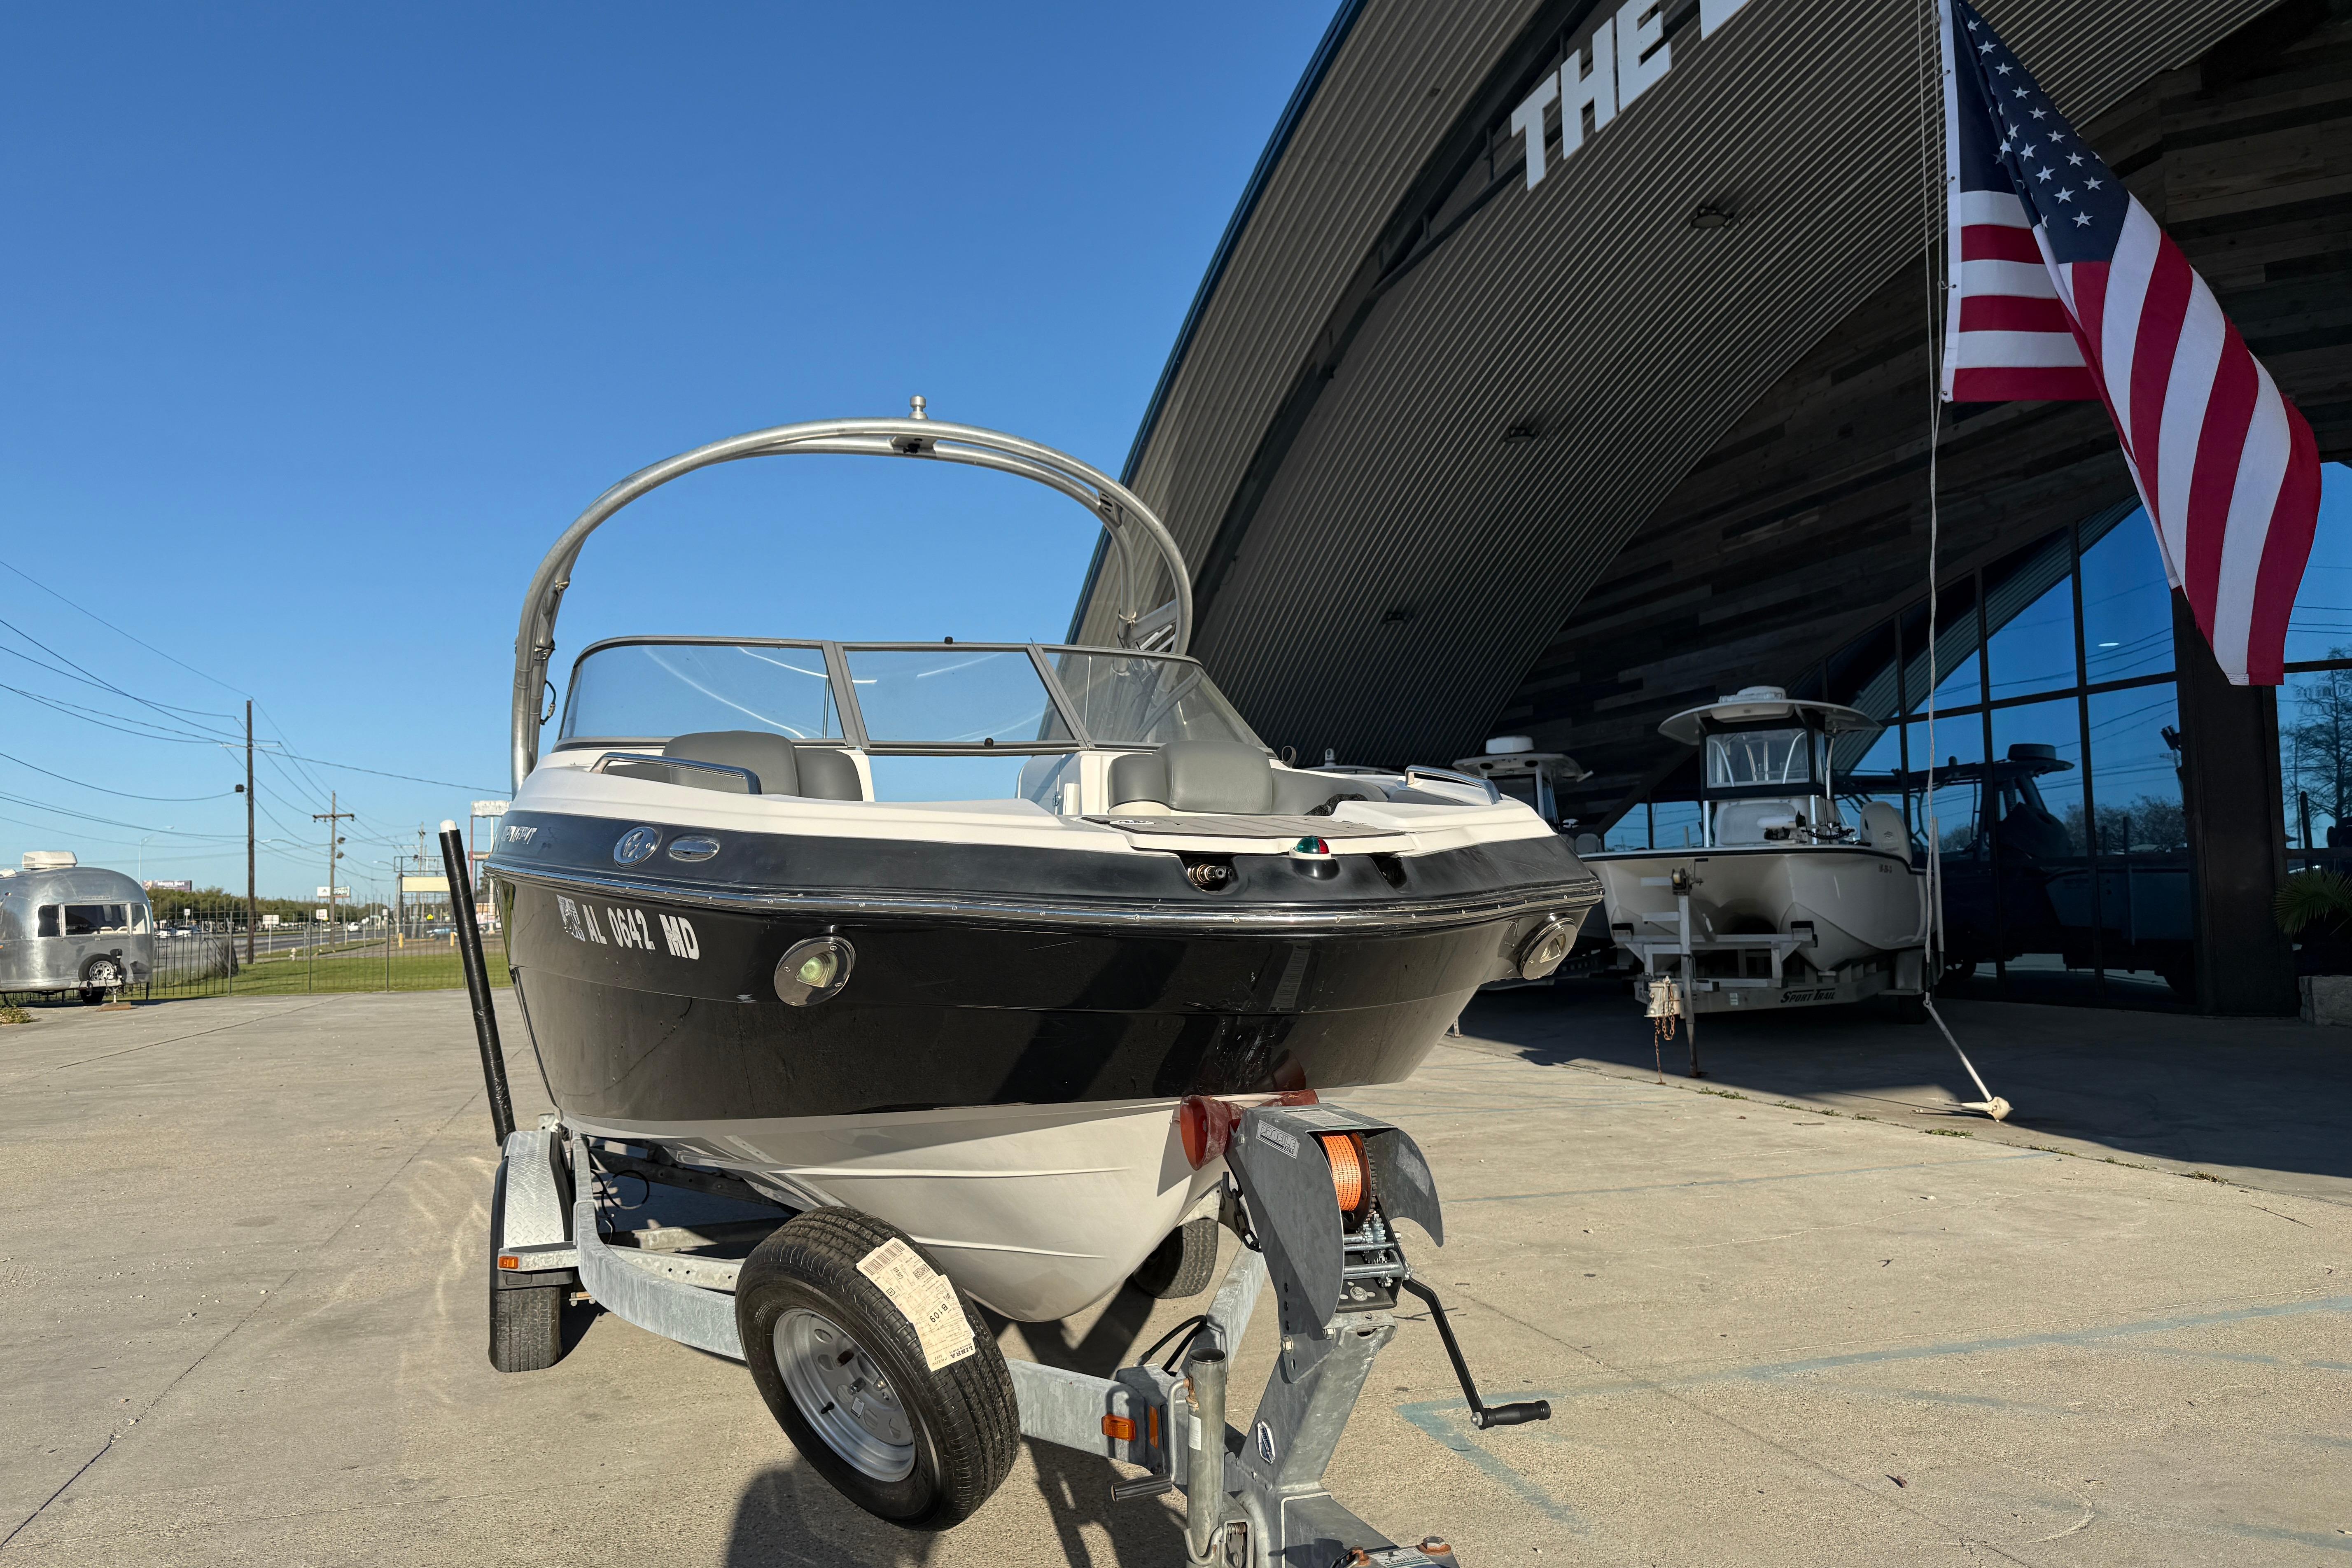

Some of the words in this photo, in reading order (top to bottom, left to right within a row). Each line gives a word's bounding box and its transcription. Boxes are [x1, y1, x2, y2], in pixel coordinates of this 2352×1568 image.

[1511, 0, 1672, 191] THE
[582, 904, 607, 945] AL
[607, 907, 656, 950] 0642
[659, 914, 699, 960] MD
[1780, 990, 1813, 1003] SPORT
[1813, 988, 1836, 1001] TRAIL
[1260, 1124, 1296, 1151] PROFILE
[930, 1304, 948, 1323] B109
[950, 1346, 973, 1358] LIBRA
